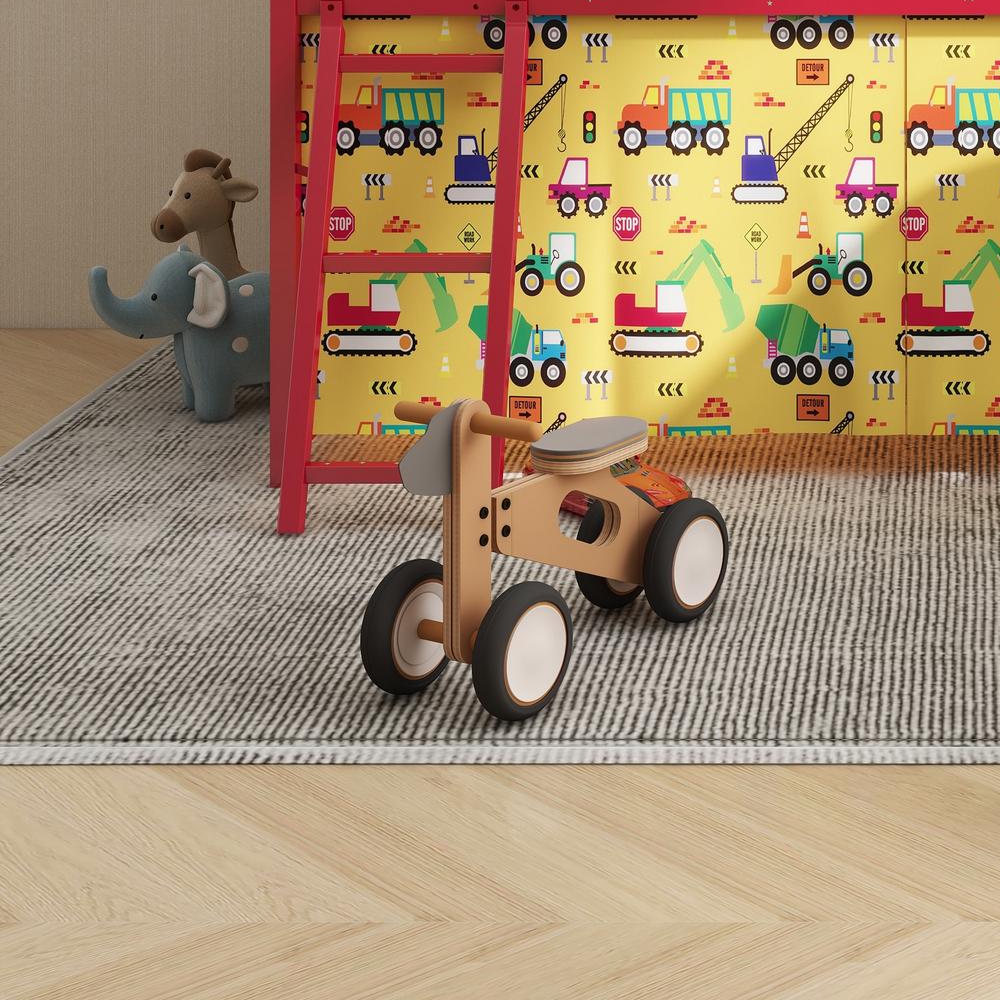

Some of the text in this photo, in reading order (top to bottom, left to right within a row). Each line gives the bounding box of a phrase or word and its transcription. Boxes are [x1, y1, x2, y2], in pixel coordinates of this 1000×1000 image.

[801, 63, 825, 72] DETOUR
[329, 217, 352, 231] STOP
[615, 217, 639, 231] STOP
[902, 217, 926, 231] STOP
[514, 400, 537, 409] DETOUR
[801, 398, 825, 407] DETOUR
